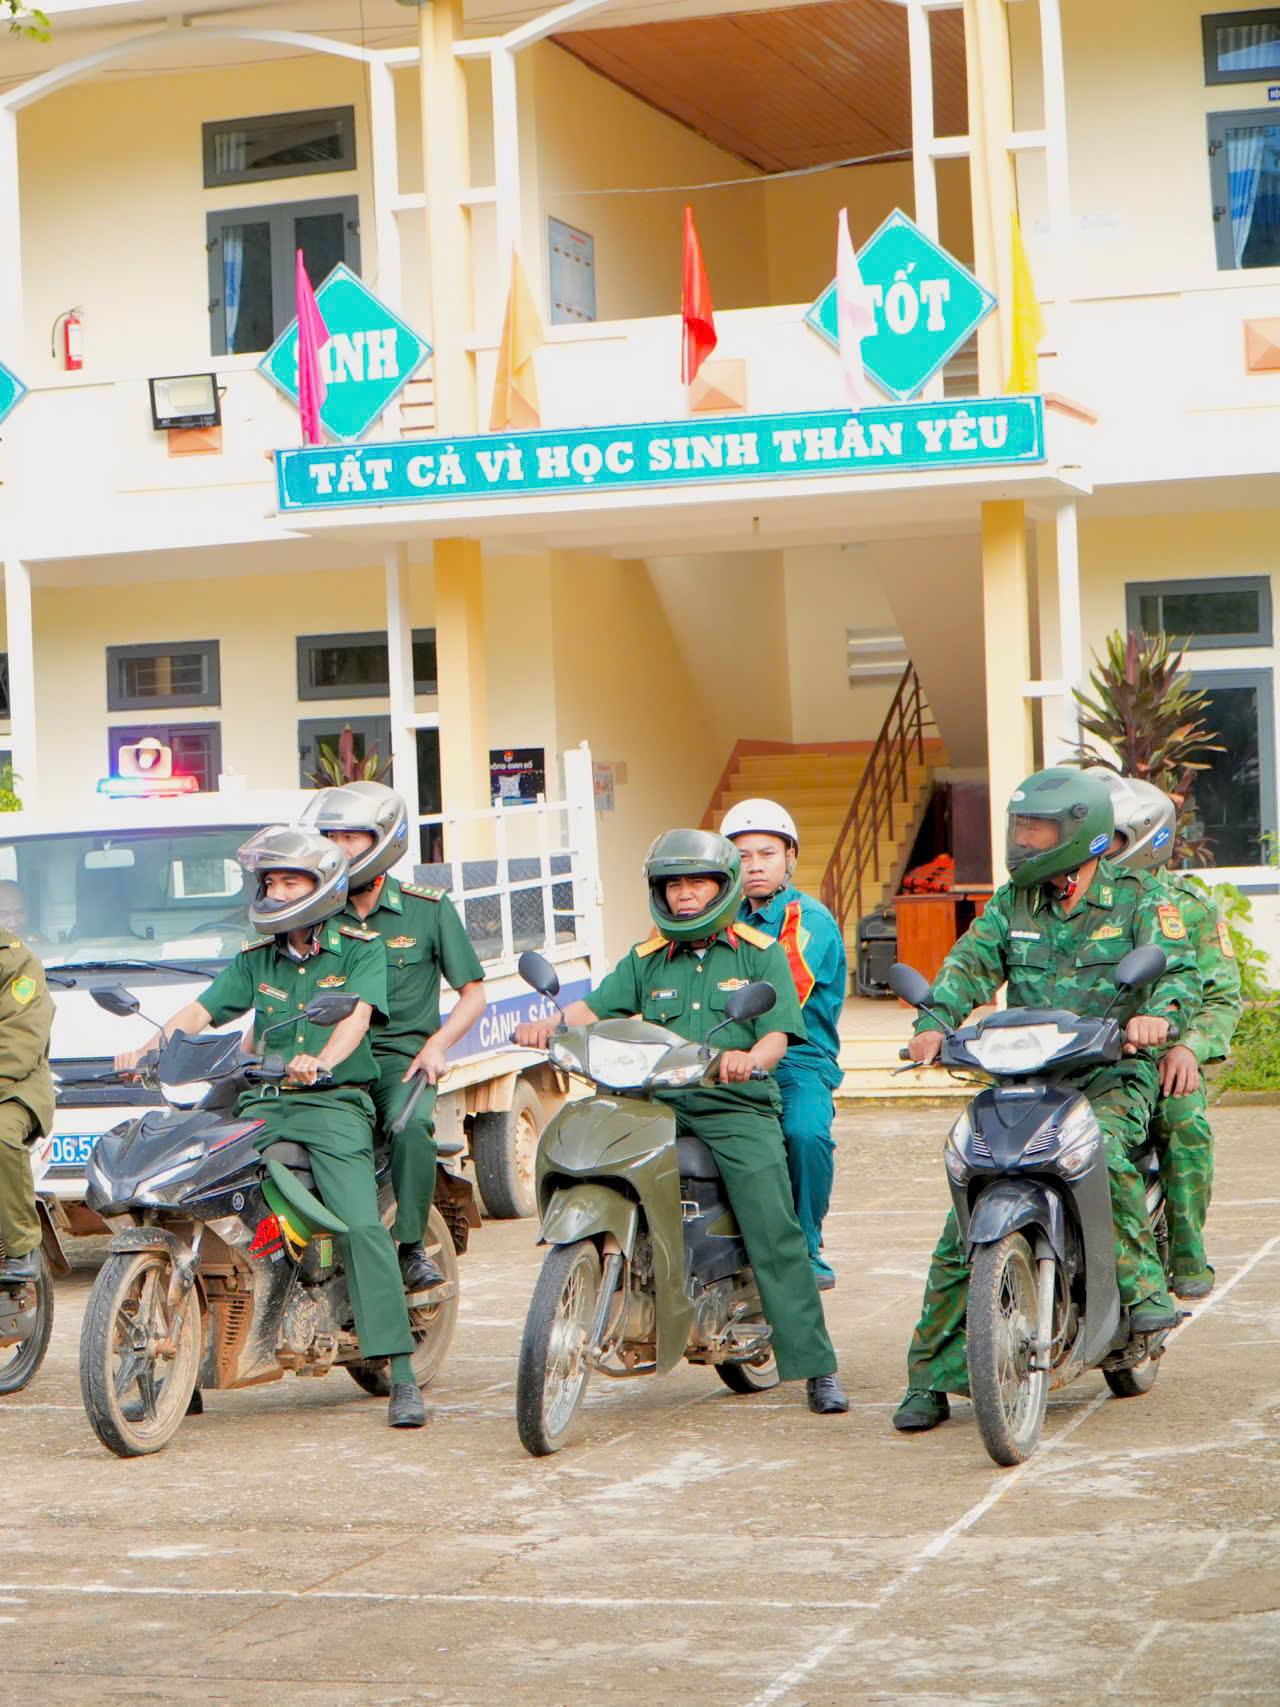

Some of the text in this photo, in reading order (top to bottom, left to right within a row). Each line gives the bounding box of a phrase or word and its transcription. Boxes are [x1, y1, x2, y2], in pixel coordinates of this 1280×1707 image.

[294, 327, 400, 388] INH
[309, 409, 1008, 495] TẤT CẢ VÌ HỌC SINH THÂN YÊU
[480, 1005, 521, 1047] CẢNH
